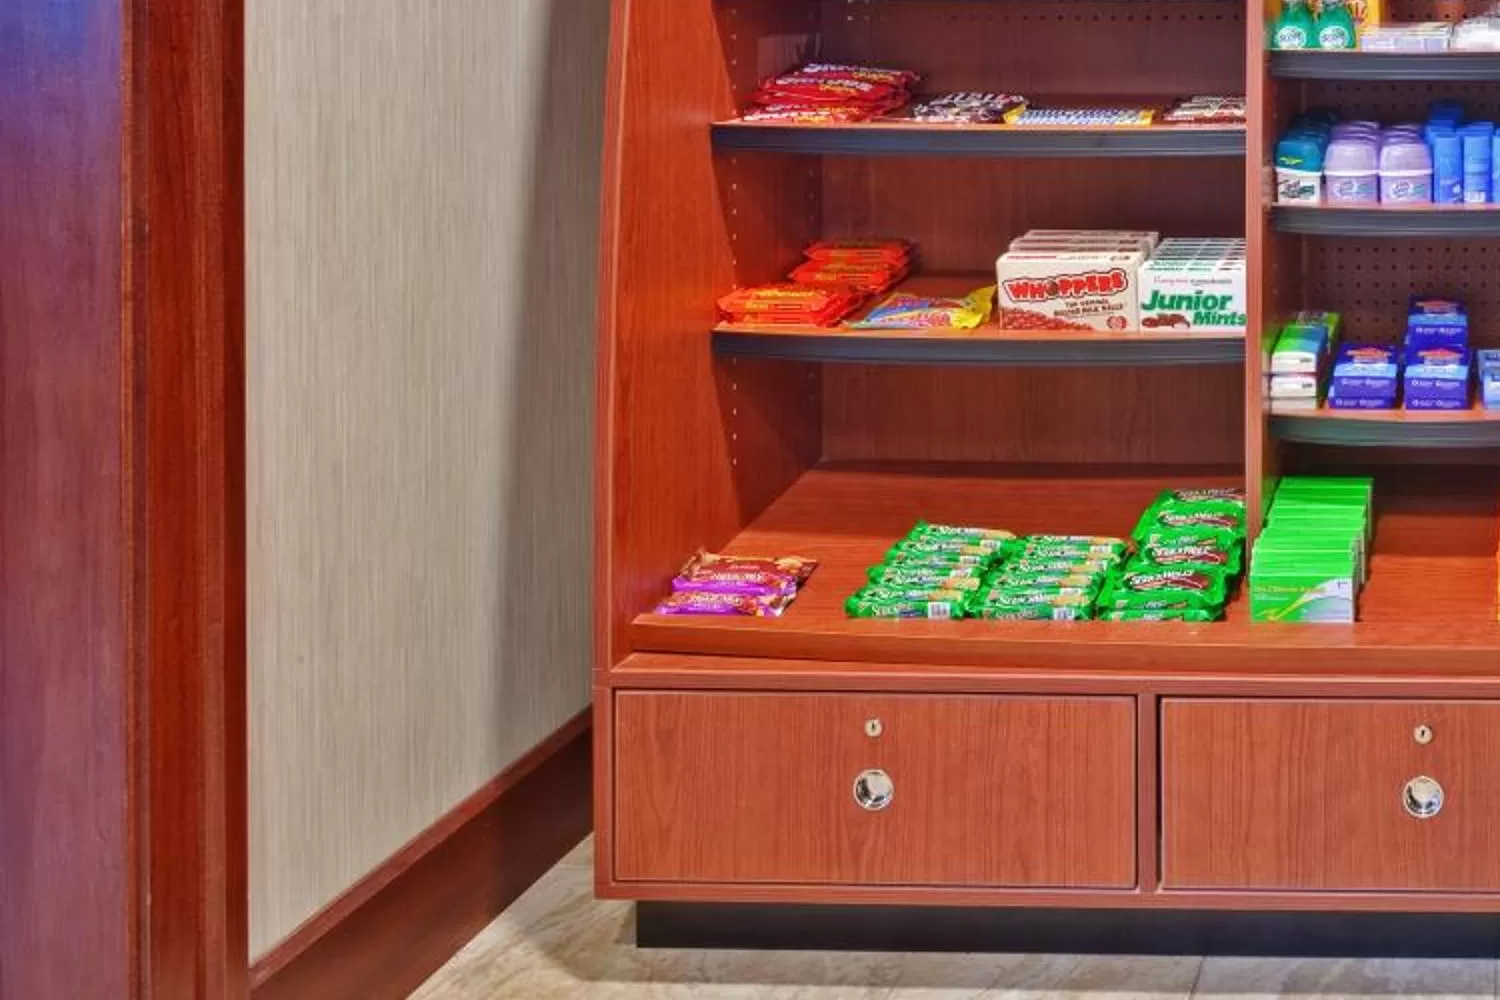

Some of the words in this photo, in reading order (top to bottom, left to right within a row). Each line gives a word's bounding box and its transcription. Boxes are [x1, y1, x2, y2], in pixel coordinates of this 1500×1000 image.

[1006, 270, 1127, 301] WHOPPERS
[1141, 289, 1232, 312] Junior
[1191, 310, 1247, 327] Mints
